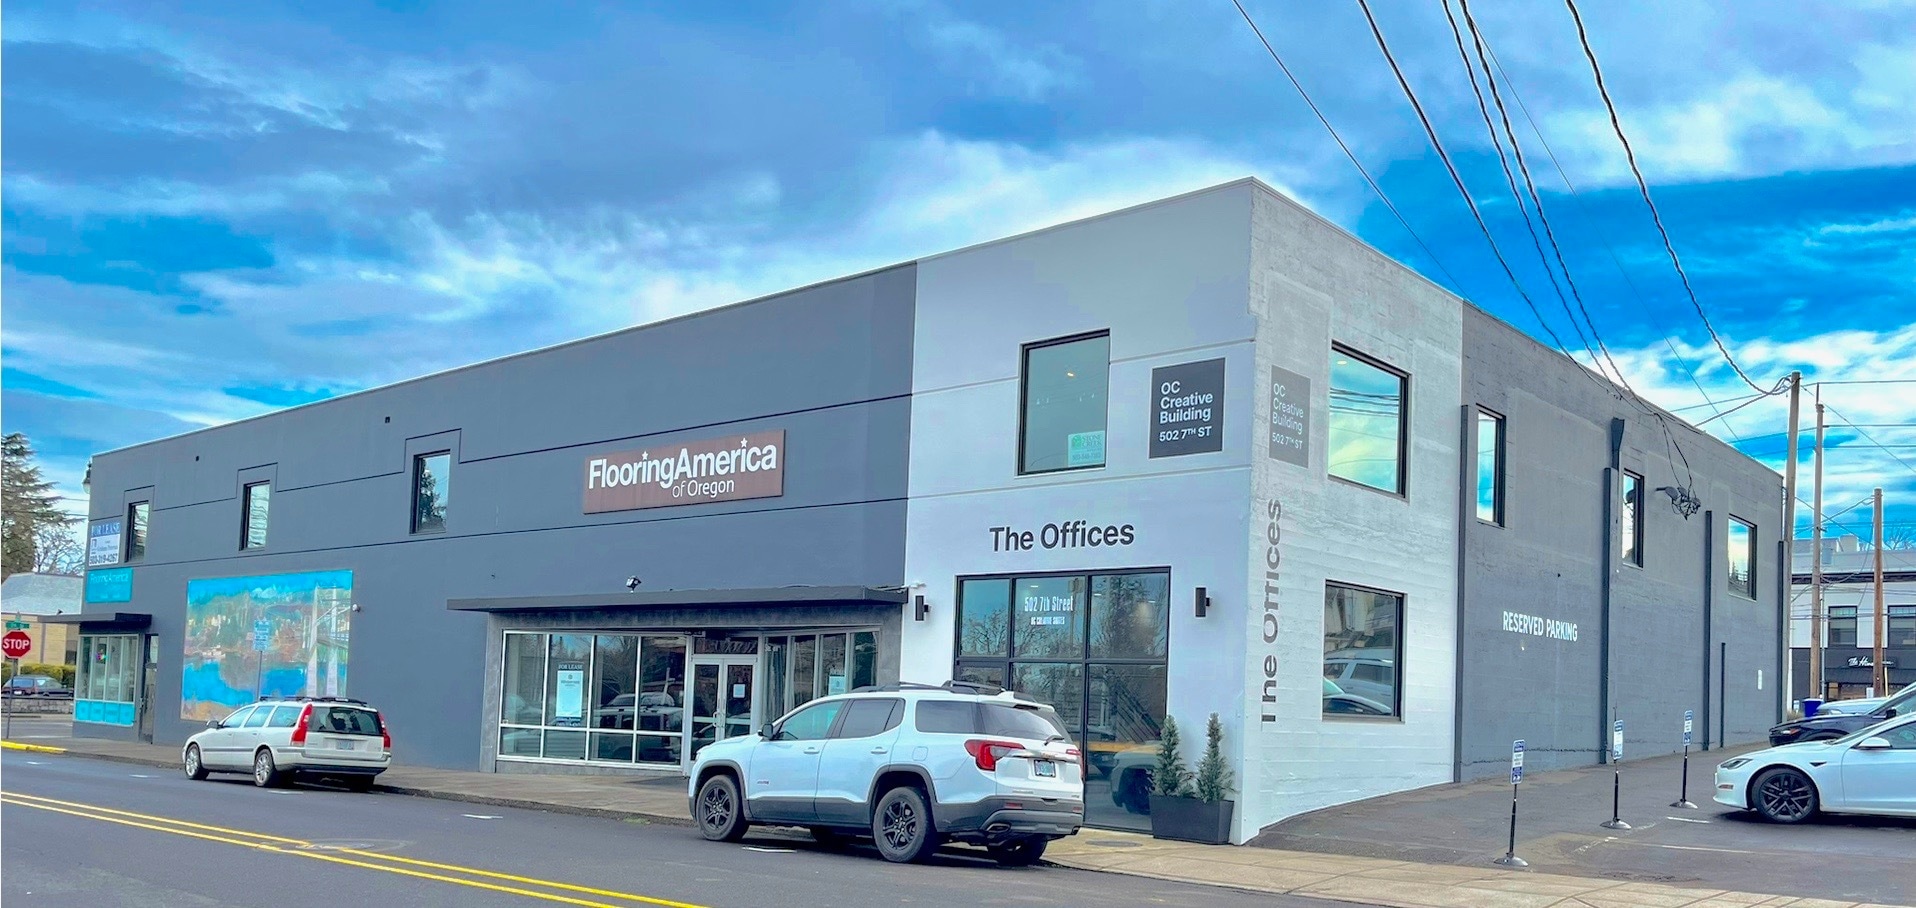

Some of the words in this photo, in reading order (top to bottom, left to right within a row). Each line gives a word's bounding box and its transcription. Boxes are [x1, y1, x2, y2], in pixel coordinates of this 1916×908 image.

[1160, 380, 1180, 395] OC
[1273, 383, 1286, 397] OC
[1160, 392, 1213, 409] Creative
[1273, 398, 1304, 418] Creative
[1160, 407, 1212, 424] Building
[1272, 411, 1303, 435] Building
[1159, 429, 1179, 442] 502
[1180, 427, 1196, 440] 7TH
[1198, 425, 1212, 438] ST
[1272, 432, 1285, 445] 502
[1295, 439, 1303, 450] ST
[588, 437, 777, 490] FlooringAmerica
[672, 481, 686, 498] of
[687, 479, 735, 498] Oregon
[989, 526, 1034, 552] The
[1040, 519, 1135, 550] Offices
[1024, 596, 1038, 612] 502
[1039, 596, 1050, 612] 7th
[1051, 595, 1073, 612] Street
[1503, 610, 1544, 636] RESERVED
[1546, 618, 1578, 642] PARKING
[2, 638, 30, 650] STOP
